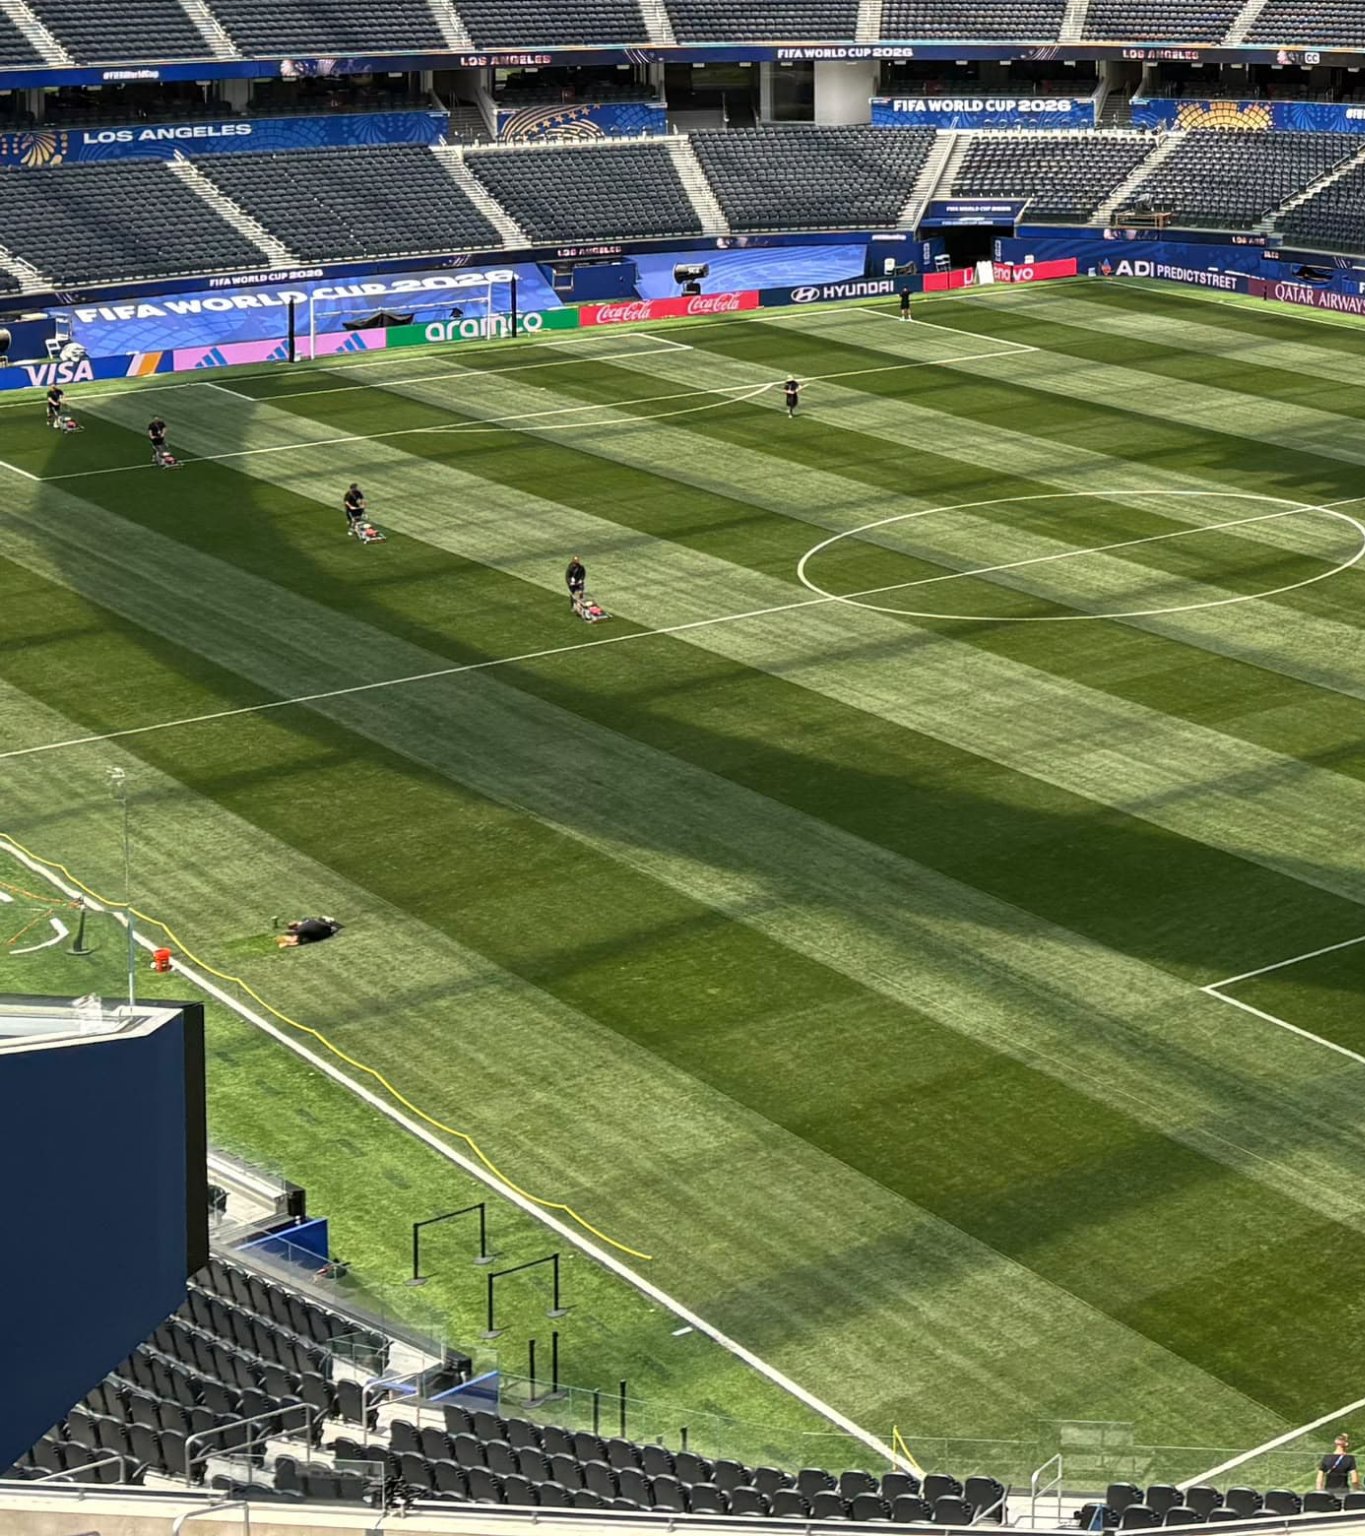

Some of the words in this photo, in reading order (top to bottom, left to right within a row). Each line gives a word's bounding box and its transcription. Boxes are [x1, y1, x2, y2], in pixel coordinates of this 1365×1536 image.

[460, 56, 487, 66] LOS
[490, 55, 552, 65] ANGELES
[777, 49, 803, 59] FIFA
[804, 48, 847, 59] WORLD
[848, 48, 871, 58] CUP
[872, 48, 913, 57] 2026
[1123, 50, 1144, 59] LOS
[894, 100, 926, 112] FIFA
[929, 100, 984, 112] WORLD
[986, 100, 1016, 112] CUP
[1018, 100, 1071, 112] 2026
[84, 130, 134, 144] LOS
[138, 124, 253, 141] ANGELES
[209, 277, 231, 287] FIFA
[232, 275, 267, 285] WORLD
[268, 271, 288, 282] CUP
[288, 268, 324, 279] 2026
[1156, 264, 1238, 290] PREDICTSTREET
[75, 303, 168, 323] FIFA
[163, 291, 308, 315] WORLD
[313, 283, 387, 300] CUP
[391, 269, 519, 292] 2026
[823, 280, 894, 299] HYUNDAI
[1275, 284, 1314, 305] QATAR
[596, 300, 653, 324] Coca-Cola
[687, 292, 741, 315] Coca-Cola
[425, 312, 542, 342] aramco
[20, 360, 95, 386] VISA
